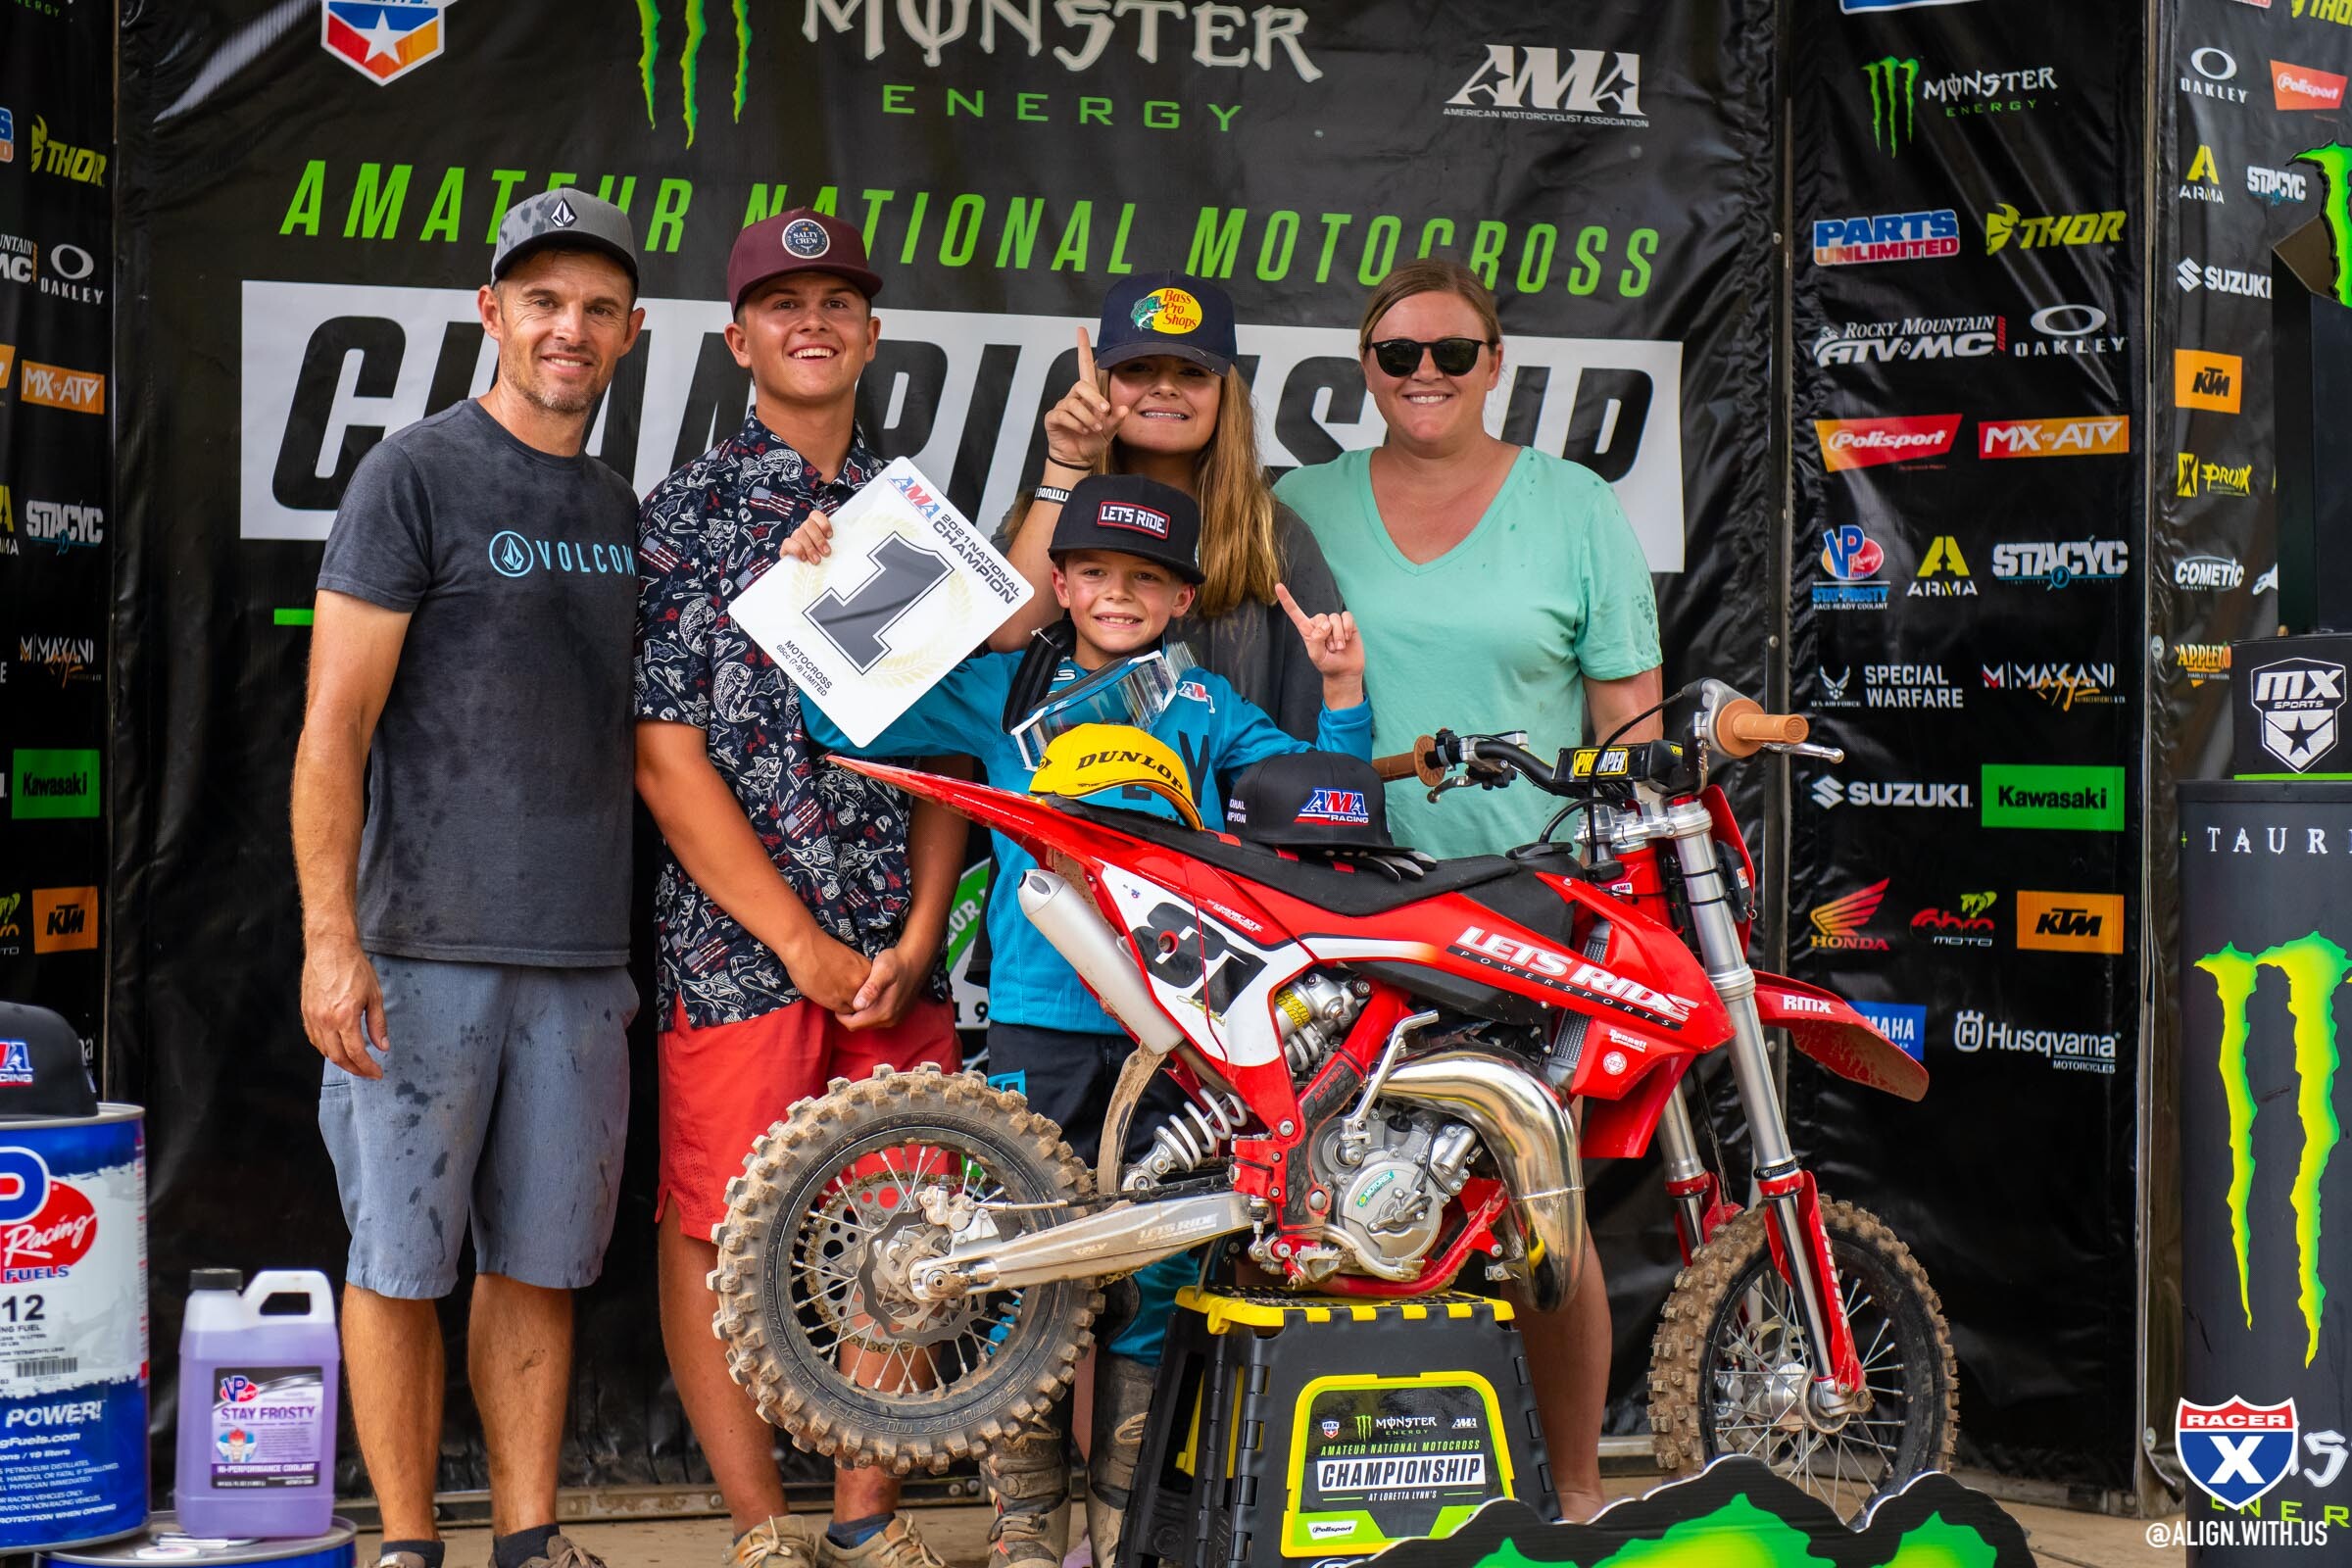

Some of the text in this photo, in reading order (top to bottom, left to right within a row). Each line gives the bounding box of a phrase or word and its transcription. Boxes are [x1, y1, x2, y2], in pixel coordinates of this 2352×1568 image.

[1445, 44, 1647, 117] AMA
[1923, 67, 2058, 102] MONSTER
[2180, 77, 2248, 104] OAKLEY
[2278, 73, 2339, 100] Polisport
[882, 84, 1243, 132] ENERGY
[1443, 107, 1649, 128] AMERICAN MOTORCYCLIST ASSOCIATION
[1946, 99, 2037, 118] ENERGY
[46, 139, 107, 186] THOR
[2179, 184, 2225, 204] ARMA
[2247, 165, 2306, 201] STACYC
[1815, 209, 1958, 246] PARTS
[2018, 211, 2127, 250] THOR
[1815, 238, 1959, 265] UNLIMITED
[40, 277, 104, 305] OAKLEY
[2205, 266, 2272, 299] SUZUKI
[1163, 289, 1191, 304] Bass
[1164, 303, 1184, 314] Pro
[1162, 314, 1197, 329] Shops
[1845, 320, 1898, 339] ROCKY
[1900, 315, 1995, 336] MOUNTAIN
[2015, 337, 2126, 358] OAKLEY
[59, 375, 101, 405] ATV
[2192, 367, 2230, 397] KTM
[1830, 429, 1946, 450] Polisport
[2052, 421, 2123, 450] ATV
[888, 476, 941, 519] AMA
[26, 500, 103, 543] STACYC
[1136, 512, 1165, 534] RIDE
[932, 519, 1015, 605] CHAMPION
[941, 513, 1021, 598] 2021 NATIONAL
[1823, 525, 1865, 579] VP
[1992, 539, 2129, 576] STACYC
[2175, 558, 2245, 588] COMETIC
[1907, 581, 1979, 597] ARMA
[802, 531, 955, 675] 1
[784, 640, 833, 690] MOTOCROSS
[788, 657, 804, 673] (7-9)
[802, 669, 828, 698] LIMITED
[1865, 664, 1949, 686] SPECIAL
[1866, 687, 1964, 709] WARFARE
[2255, 669, 2344, 701] MX
[2274, 700, 2325, 710] SPORTS
[1076, 750, 1184, 791] DUNLOP
[23, 772, 87, 796] Kawasaki
[1848, 782, 1970, 808] SUZUKI
[1301, 789, 1369, 815] AMA
[1998, 785, 2107, 810] Kawasaki
[1330, 814, 1369, 824] RACING
[2208, 827, 2352, 855] TAUR
[47, 904, 85, 935] KTM
[2035, 907, 2102, 937] KTM
[1810, 935, 1889, 951] HONDA
[1934, 935, 1992, 947] MOTO
[1459, 950, 1671, 1027] POWERSPORTS
[1569, 963, 1698, 1022] RIDE
[1987, 1022, 2117, 1060] Husqvarna
[2053, 1060, 2116, 1074] MOTORCYCLES
[4, 1213, 97, 1267] Racing
[4, 1265, 70, 1282] FUELS
[221, 1375, 247, 1402] VP
[5, 1401, 103, 1427] POWER!
[221, 1405, 316, 1420] STAY FROSTY
[1376, 1416, 1437, 1428] MONSTER
[1451, 1418, 1478, 1429] AMA
[1321, 1440, 1480, 1456] AMATEUR NATIONAL MOTOCROSS
[5, 1464, 49, 1474] PETROLEUM
[283, 1463, 315, 1472] COOLANT
[1322, 1457, 1481, 1488] CHAMPIONSHIP
[10, 1482, 48, 1491] PHYSICIAN
[36, 1493, 66, 1501] VEHICLES
[1379, 1492, 1409, 1500] LORETTA
[1412, 1491, 1437, 1499] LYNN'S
[32, 1499, 74, 1509] NON-RACING
[56, 1510, 81, 1519] WHEN
[83, 1504, 117, 1515] OPENING
[1313, 1525, 1352, 1534] Polisport
